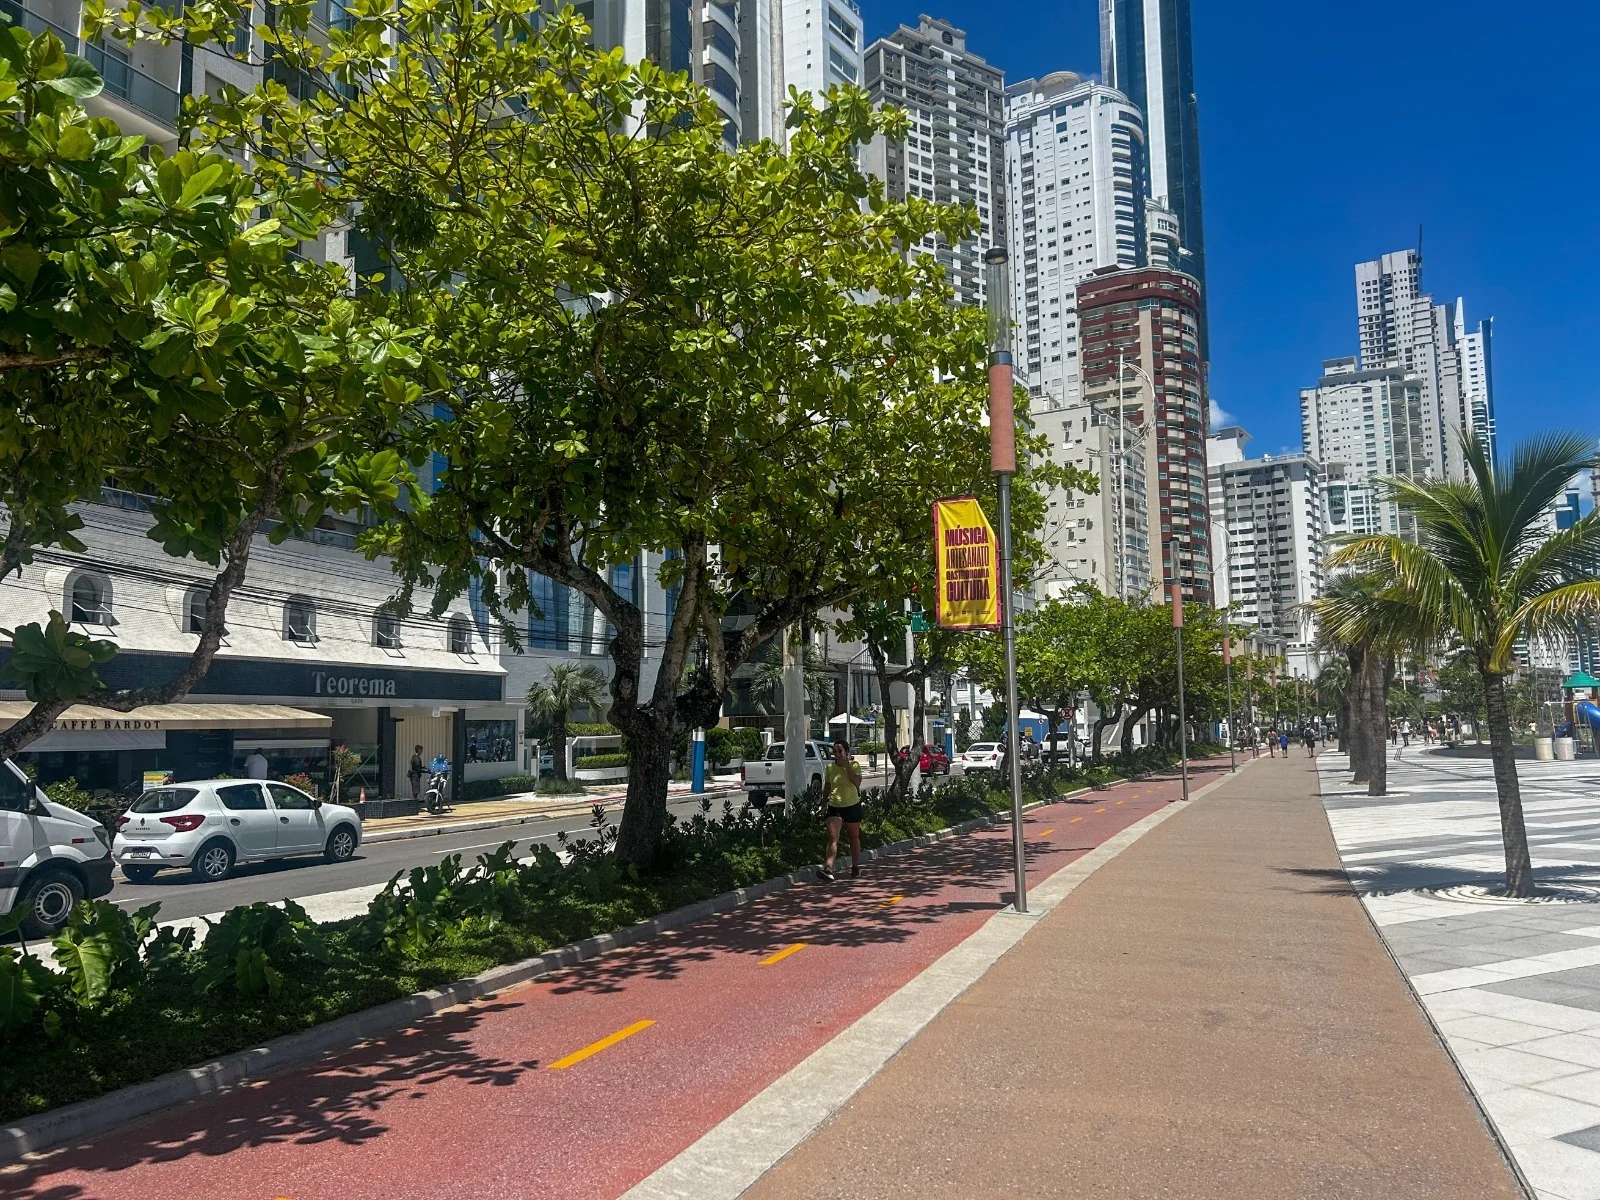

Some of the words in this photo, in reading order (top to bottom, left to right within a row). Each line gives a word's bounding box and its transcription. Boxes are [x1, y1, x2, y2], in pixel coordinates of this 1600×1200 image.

[945, 525, 988, 547] MÚSICA
[946, 547, 989, 569] ARTESANATO
[946, 569, 990, 580] GASTRONOMIA
[946, 580, 990, 602] CULTURA
[312, 671, 396, 696] Teorema
[104, 720, 161, 729] BARDOT
